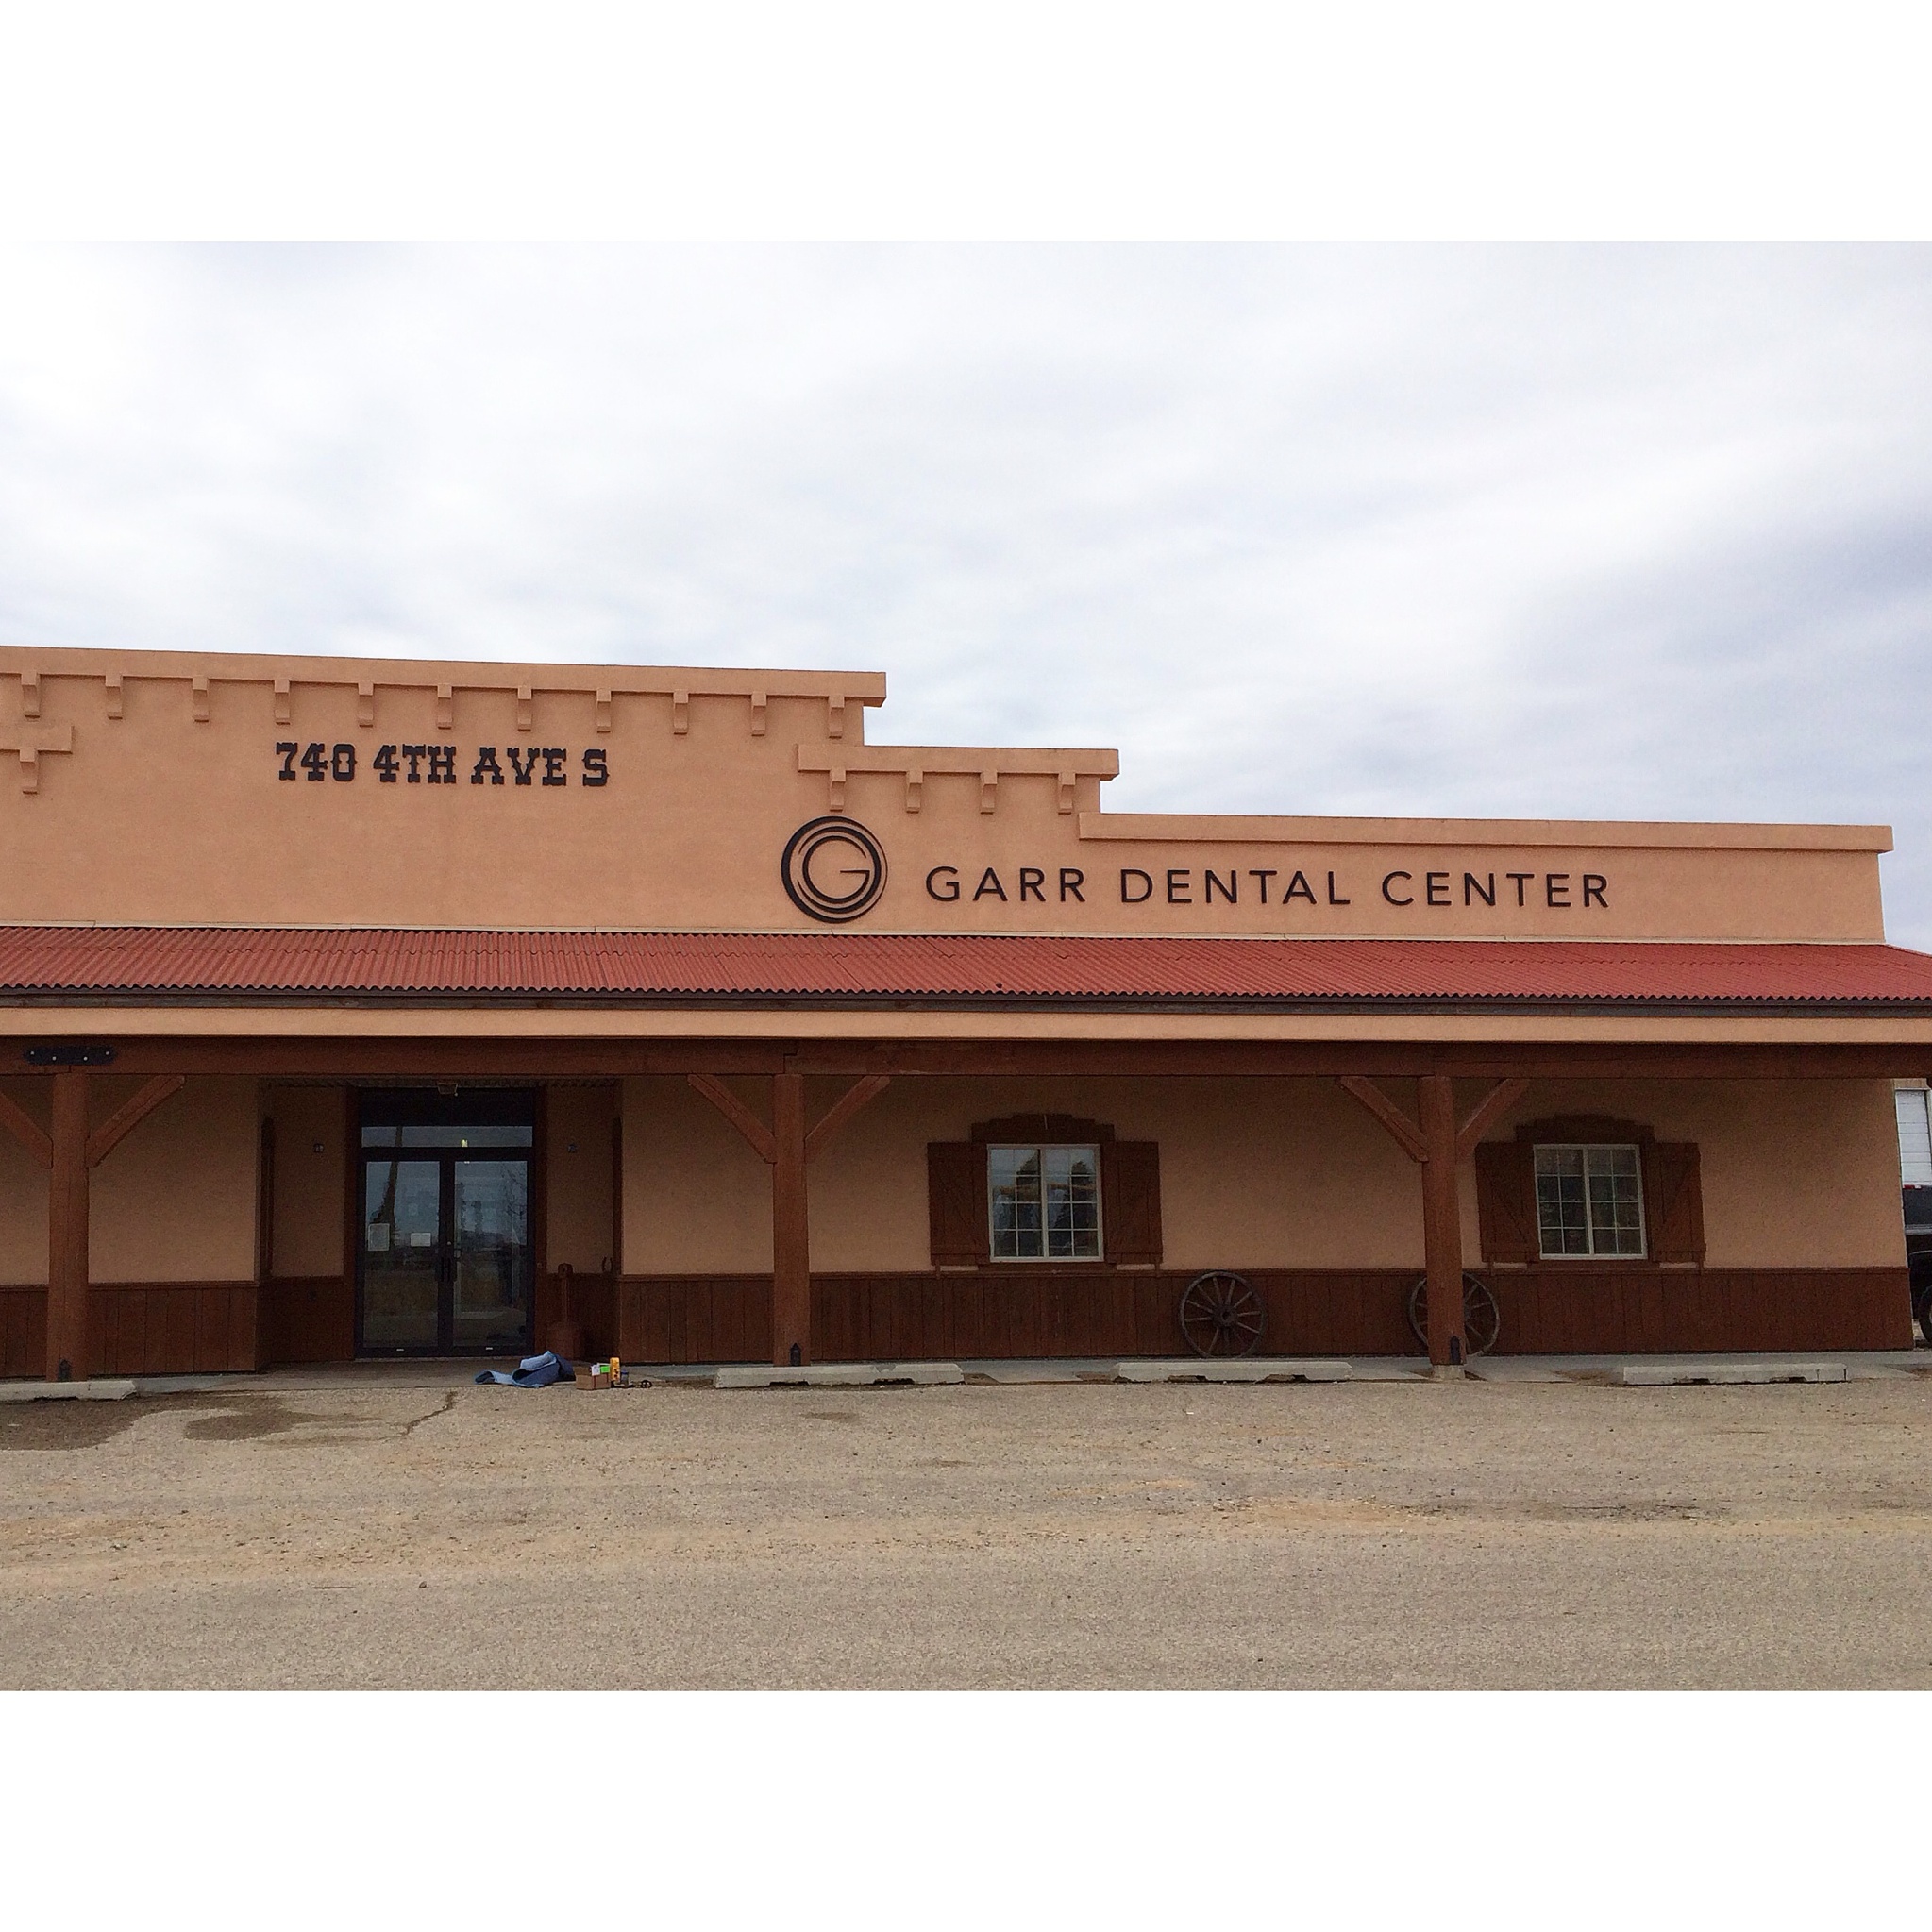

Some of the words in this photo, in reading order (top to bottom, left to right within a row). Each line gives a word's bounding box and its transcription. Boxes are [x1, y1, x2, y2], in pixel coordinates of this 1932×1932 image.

[277, 741, 357, 781] 740
[373, 744, 457, 783] 4TH
[471, 747, 567, 786] AVE
[581, 748, 611, 787] S
[925, 865, 1086, 902] GARR
[1120, 868, 1351, 905] DENTAL
[1381, 871, 1609, 907] CENTER
